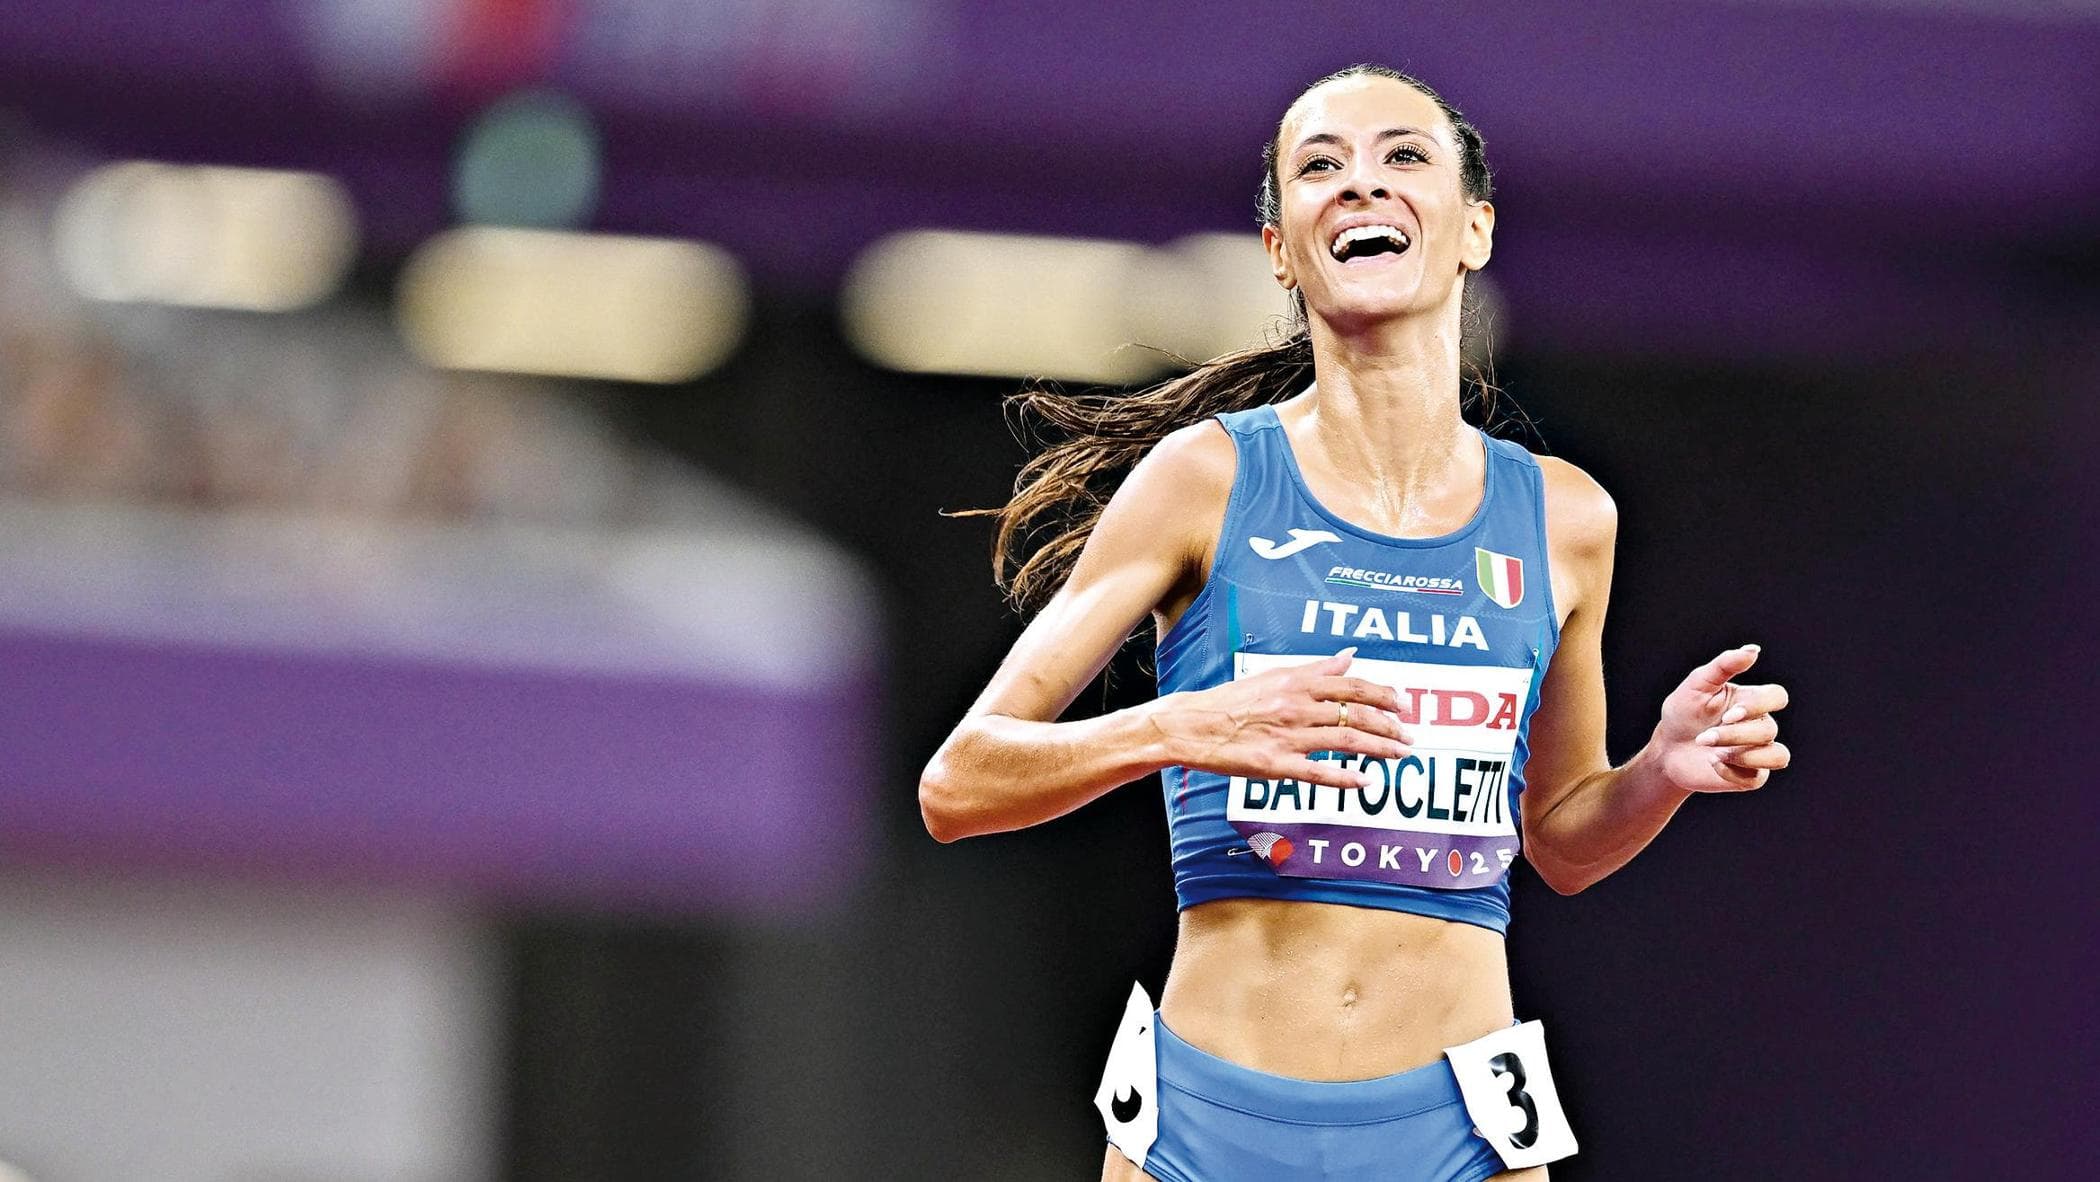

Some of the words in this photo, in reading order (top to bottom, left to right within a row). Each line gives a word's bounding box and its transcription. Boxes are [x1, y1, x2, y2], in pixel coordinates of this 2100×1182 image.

[1328, 566, 1464, 590] FRECCIAROSSA
[1301, 600, 1490, 651] ITALIA
[1396, 688, 1517, 730] NDA
[1488, 1052, 1540, 1150] 3
